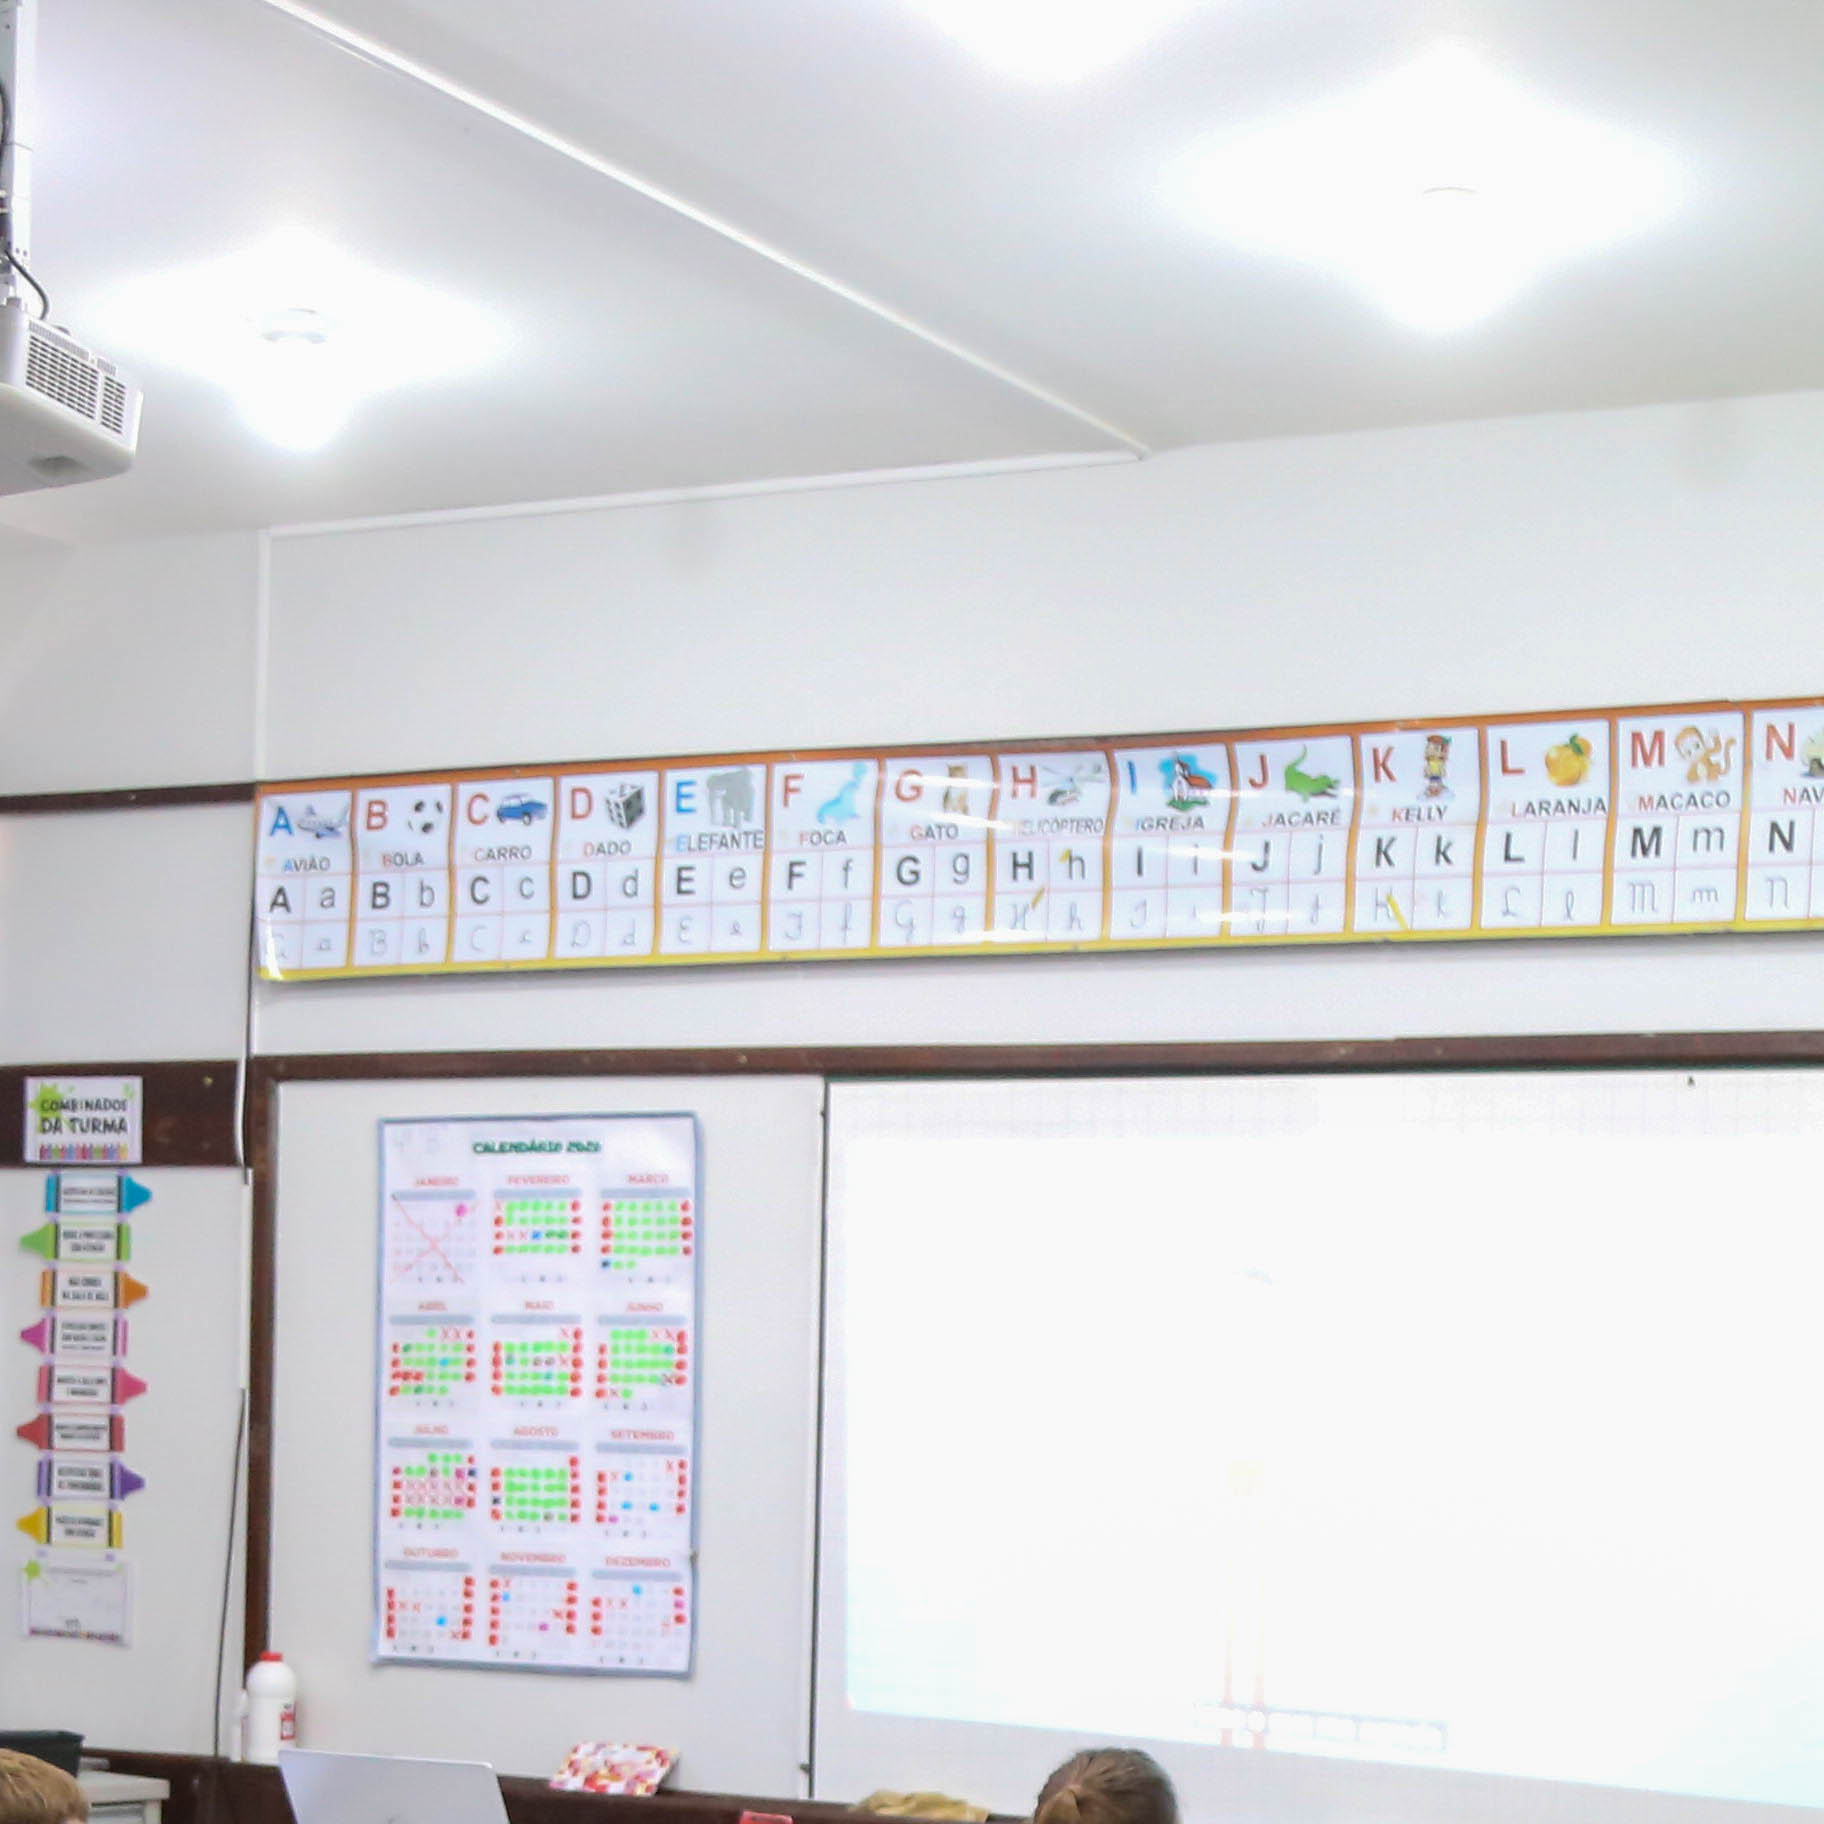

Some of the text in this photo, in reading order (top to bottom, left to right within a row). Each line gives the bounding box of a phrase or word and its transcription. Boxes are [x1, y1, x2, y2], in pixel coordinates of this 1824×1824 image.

[1631, 730, 1666, 768] M
[1766, 722, 1796, 761] N
[1249, 754, 1269, 789] J
[1372, 746, 1397, 783] K
[1500, 739, 1525, 776] L
[783, 774, 804, 808] F
[895, 769, 923, 803] G
[1012, 765, 1037, 799] H
[1128, 760, 1136, 794] I
[467, 793, 488, 825] C
[570, 787, 592, 820] D
[676, 780, 697, 814] E
[1512, 798, 1607, 818] LARANJA
[1638, 790, 1730, 811] MACACO
[270, 806, 294, 836] A
[366, 799, 388, 831] B
[1136, 816, 1204, 832] IGREJA
[1262, 807, 1340, 827] JACARÉ
[1392, 805, 1448, 822] KELLY
[676, 830, 764, 852] ELEFANTE
[799, 830, 847, 846] FOCA
[911, 823, 959, 840] GATO
[1630, 826, 1663, 858] M
[1768, 820, 1795, 853] N
[382, 852, 424, 867] BOLA
[474, 846, 532, 861] CARRO
[583, 840, 632, 857] DADO
[1251, 840, 1271, 872] J
[1375, 836, 1397, 867] K
[1504, 832, 1525, 862] L
[676, 866, 696, 895] E
[787, 861, 806, 890] F
[896, 855, 921, 886] G
[1012, 851, 1034, 882] H
[270, 886, 291, 913] A
[372, 881, 390, 909] B
[471, 876, 489, 905] C
[572, 871, 591, 900] D
[41, 1117, 128, 1134] DA TURMA
